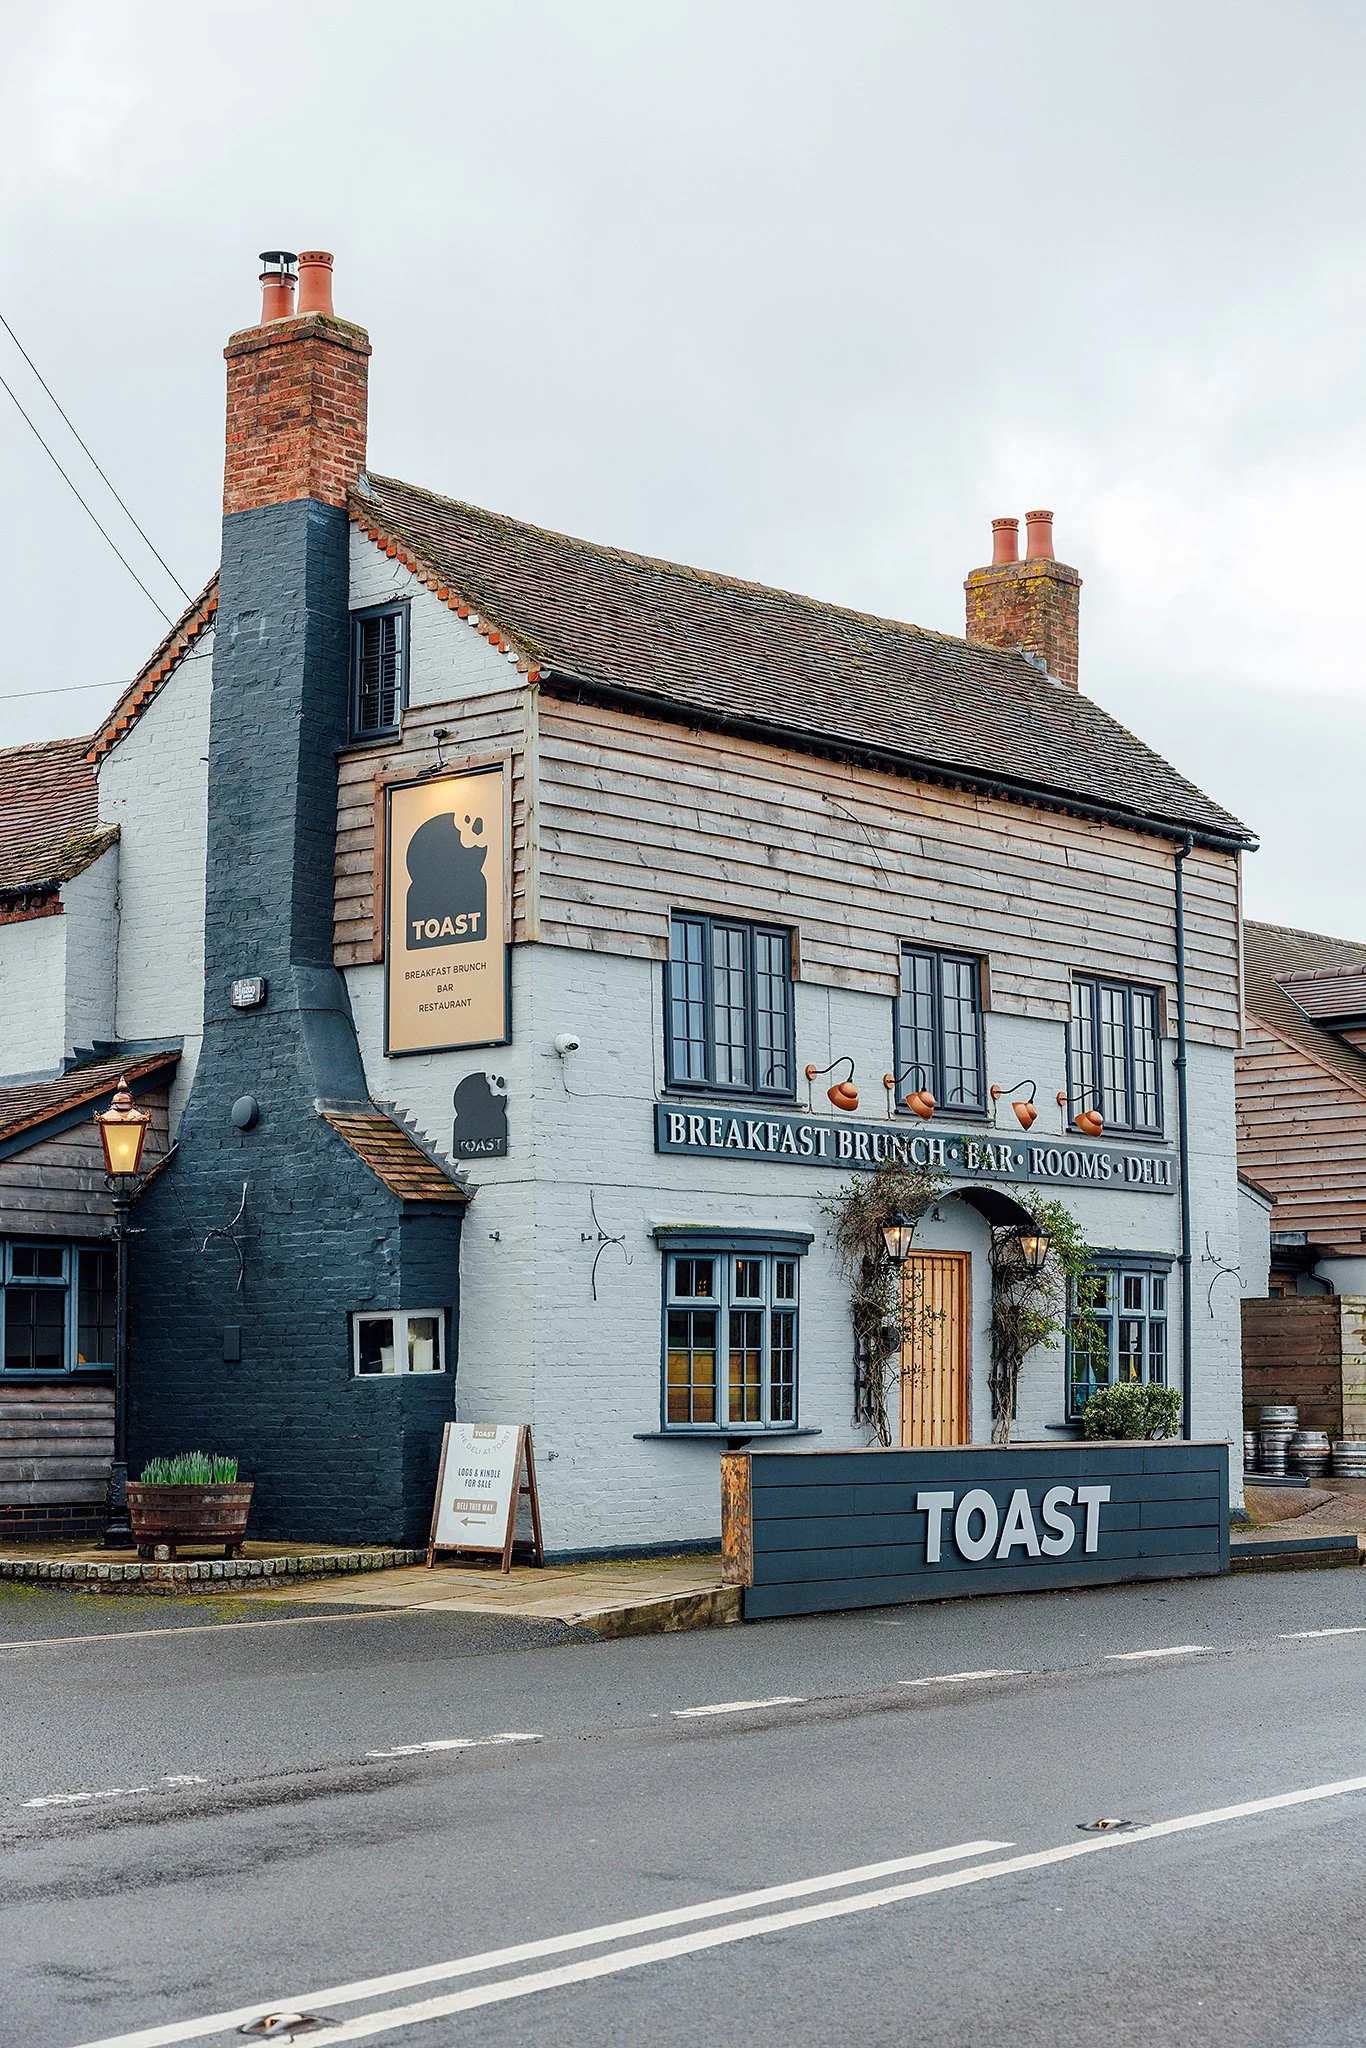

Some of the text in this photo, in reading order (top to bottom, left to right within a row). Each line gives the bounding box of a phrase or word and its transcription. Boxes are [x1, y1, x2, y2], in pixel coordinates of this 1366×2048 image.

[412, 912, 481, 940] TOAST
[405, 962, 487, 980] BREAKFAST BRUNCH
[437, 983, 454, 993] BAR
[418, 998, 472, 1013] RESTAURANT
[458, 1137, 503, 1152] TOAST
[668, 1112, 1173, 1186] BREAKFAST BRUNCH BAR ROOMS DELI
[459, 1427, 469, 1445] THE
[466, 1443, 481, 1455] DELI
[493, 1430, 511, 1452] TOAST
[474, 1430, 496, 1438] TOAST
[458, 1468, 501, 1478] LOGS & KINDLE
[464, 1479, 491, 1488] FOR SALE
[456, 1502, 468, 1510] DELI
[469, 1502, 481, 1511] THIS
[917, 1485, 1111, 1563] TOAST
